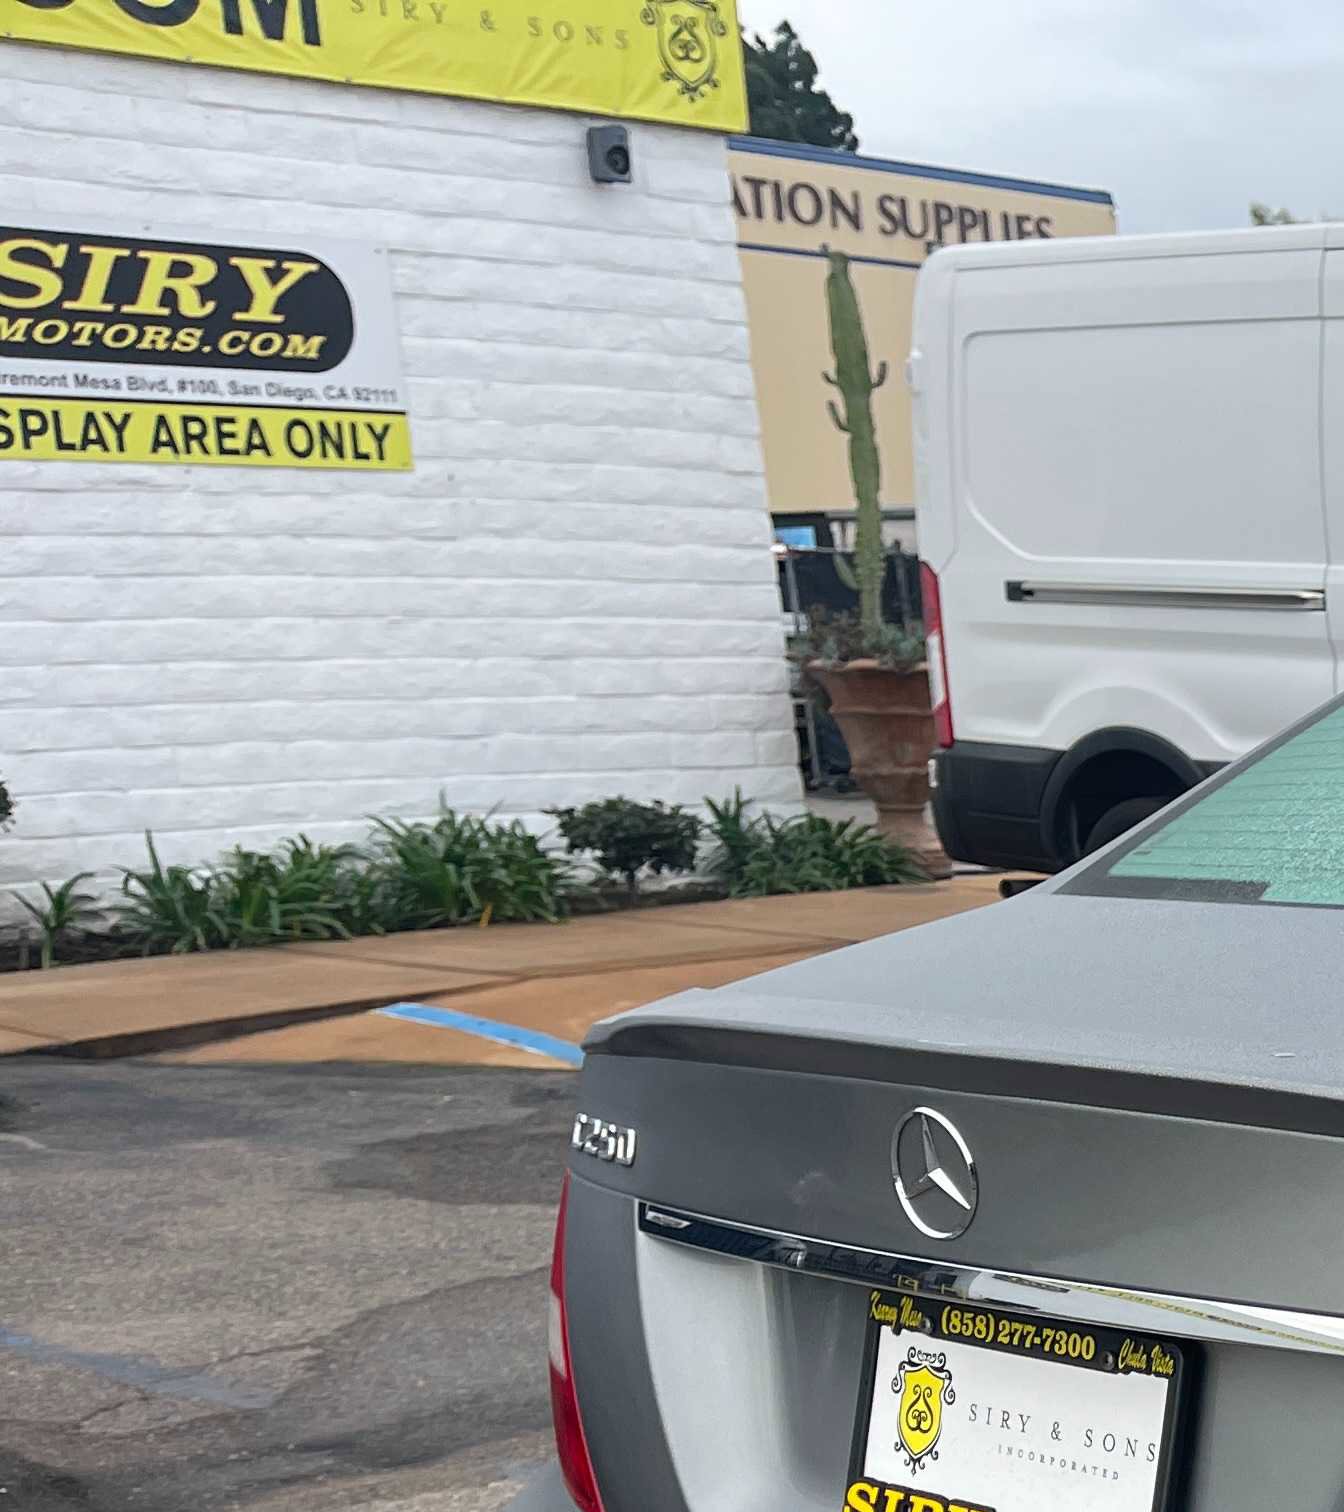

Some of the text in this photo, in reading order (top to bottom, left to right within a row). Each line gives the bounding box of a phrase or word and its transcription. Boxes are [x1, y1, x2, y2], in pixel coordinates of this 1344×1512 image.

[479, 9, 496, 32] &
[526, 17, 630, 51] SONS
[876, 193, 1056, 243] SUPPLIES
[0, 238, 320, 323] SIRY
[150, 413, 273, 458] AREA
[284, 416, 393, 461] ONLY
[572, 1112, 636, 1165] C250
[941, 1305, 1096, 1361] (858) 277-7300
[968, 1403, 1157, 1463] SIRY & SONS
[997, 1443, 1119, 1481] INCORPORATED
